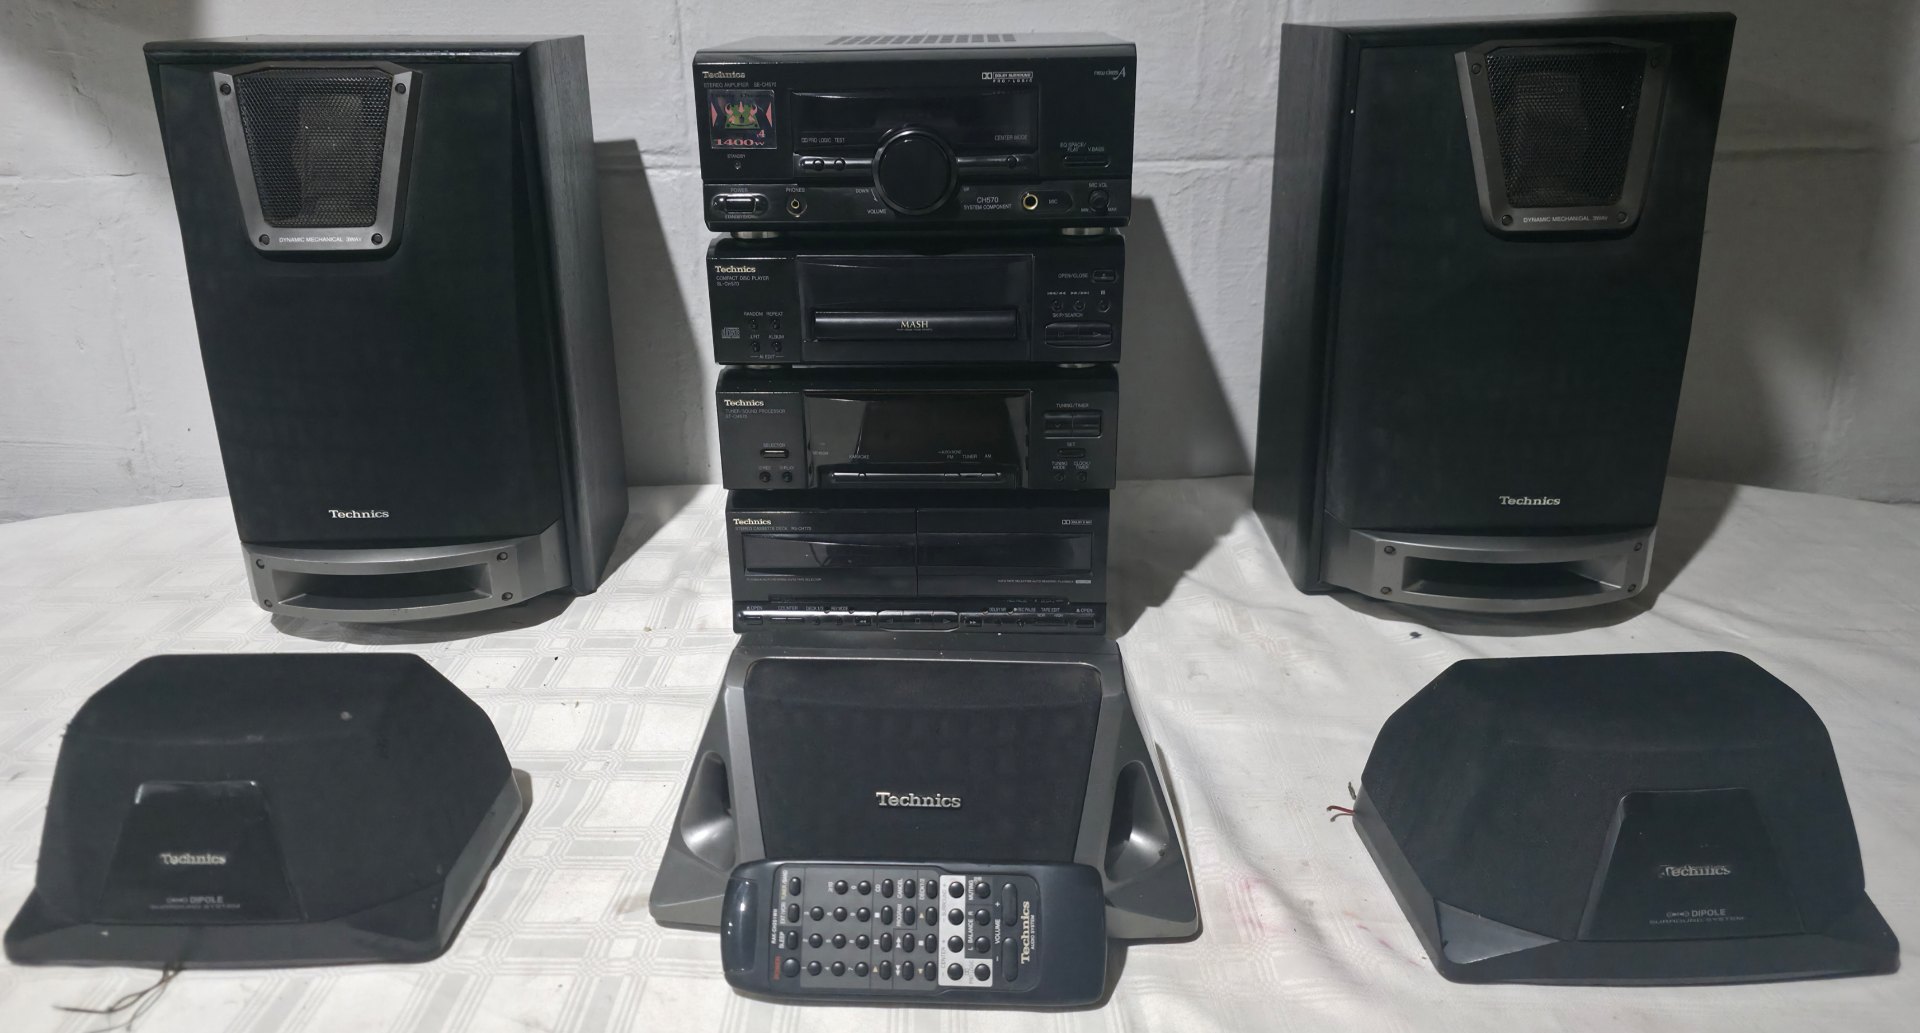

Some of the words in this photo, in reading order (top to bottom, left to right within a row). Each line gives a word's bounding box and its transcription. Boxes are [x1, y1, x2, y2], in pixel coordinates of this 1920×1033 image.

[702, 71, 746, 79] Technics
[976, 196, 999, 204] CH570
[714, 265, 756, 273] Technics
[900, 320, 929, 329] MASH
[1498, 495, 1561, 506] Technics
[328, 509, 390, 519] Technics
[875, 791, 961, 808] Technics
[159, 852, 227, 865] Technics
[1660, 864, 1732, 878] Technics
[875, 883, 881, 892] CD
[189, 895, 224, 904] DIPOLE
[1691, 908, 1726, 917] DIPOLE
[1020, 900, 1030, 964] Technics
